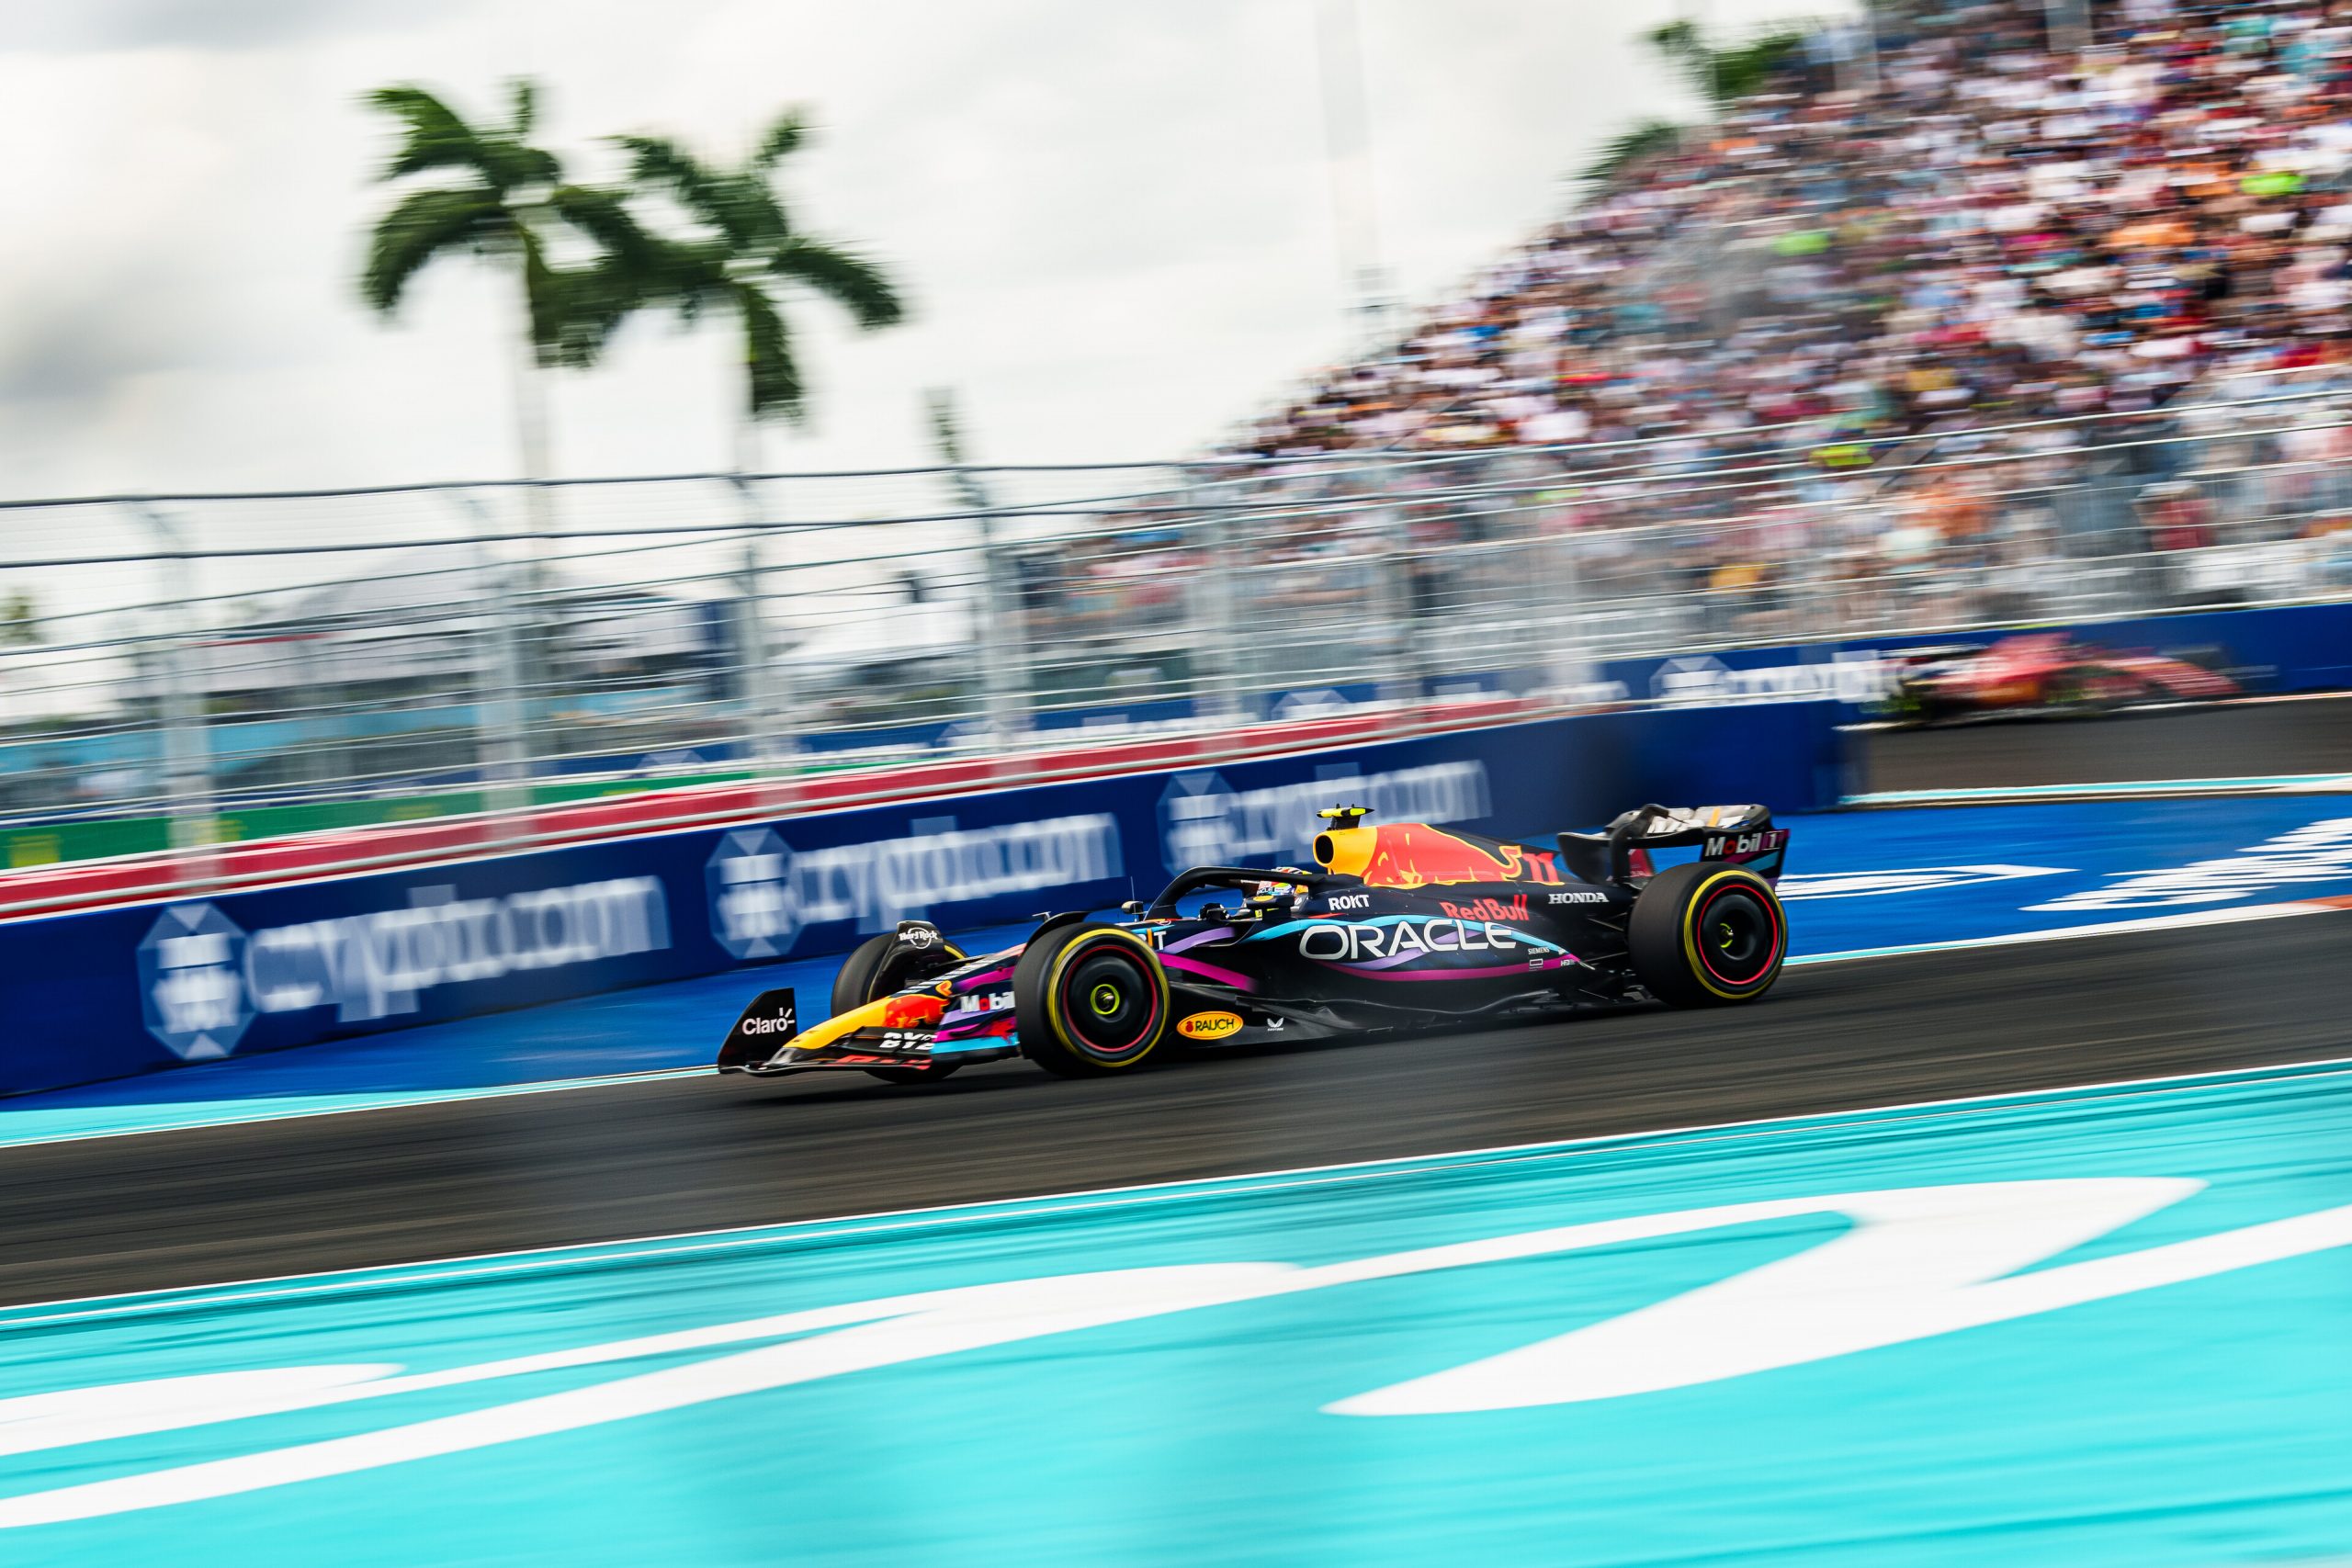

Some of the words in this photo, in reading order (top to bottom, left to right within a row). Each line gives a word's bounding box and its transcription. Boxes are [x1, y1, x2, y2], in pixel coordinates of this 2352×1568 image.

[1704, 831, 1762, 857] Mobil
[1522, 852, 1559, 882] 11
[1328, 894, 1370, 910] ROKT
[1548, 892, 1609, 905] HONDA
[1299, 919, 1516, 960] ORACLE
[741, 1017, 788, 1035] Claro
[1195, 1018, 1235, 1032] RAUCH
[878, 1032, 938, 1050] BYB
